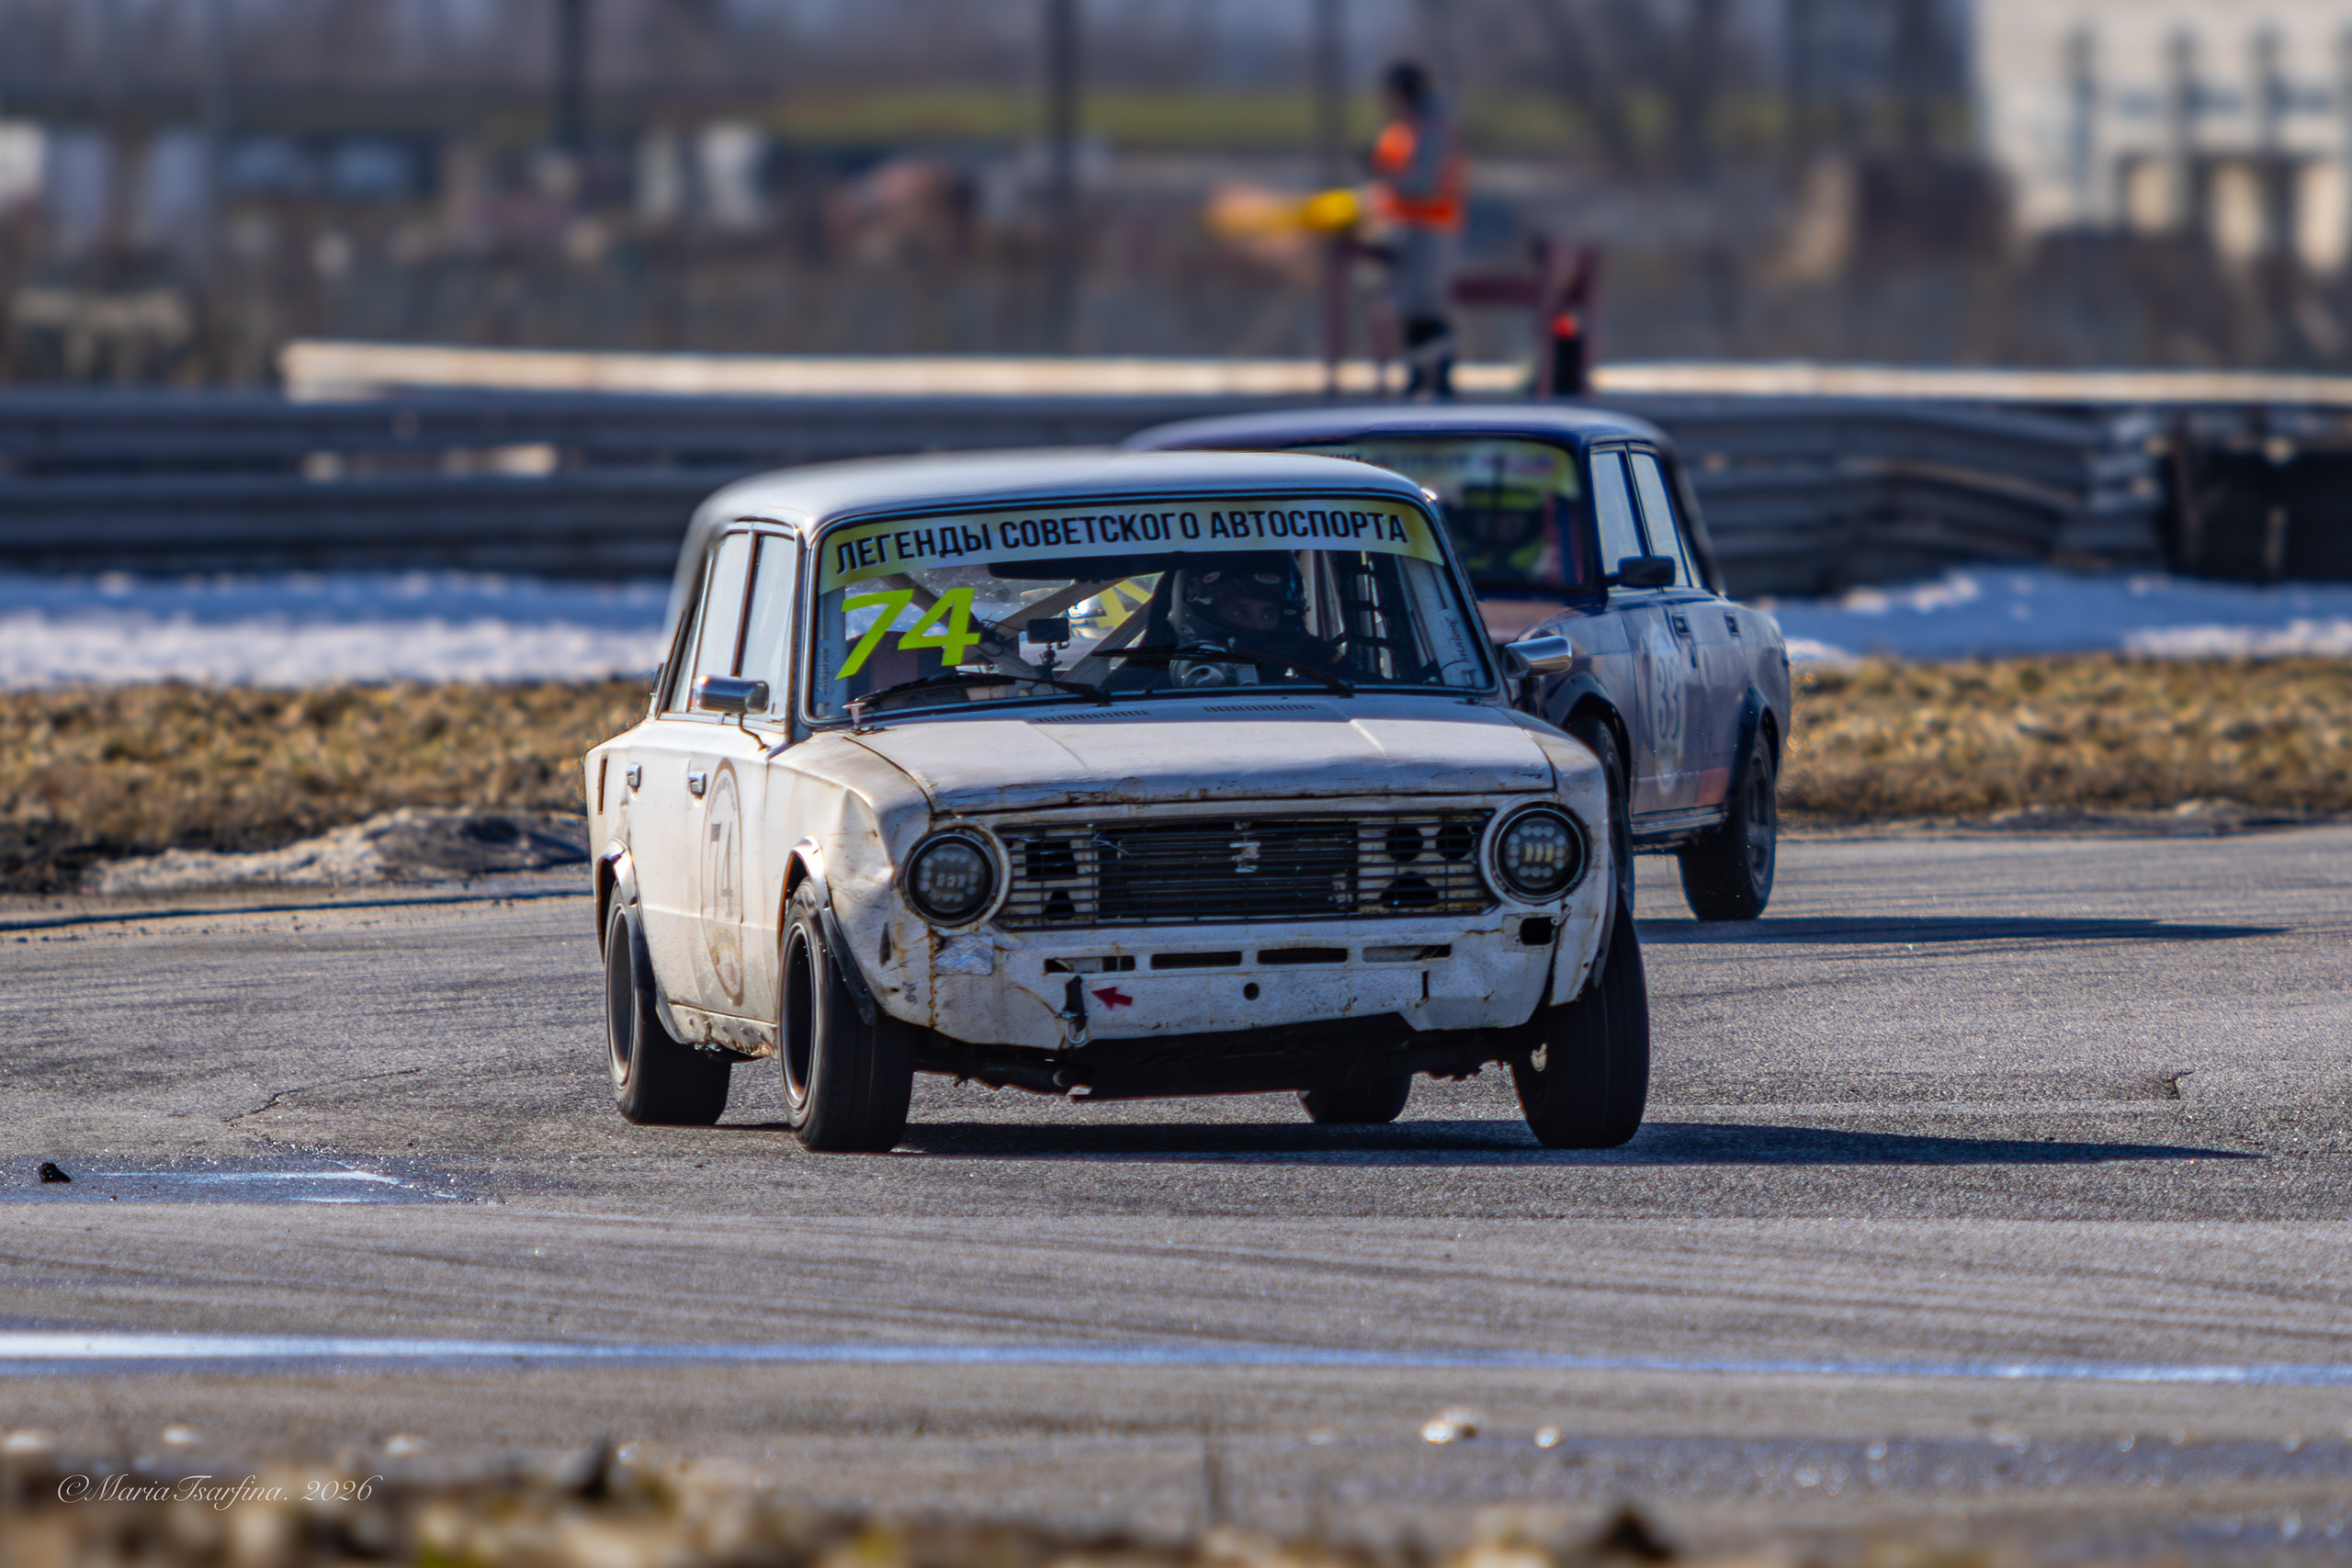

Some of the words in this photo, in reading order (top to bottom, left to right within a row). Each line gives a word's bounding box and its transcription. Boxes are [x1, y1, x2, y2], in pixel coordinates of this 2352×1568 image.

[836, 523, 992, 575] ЛЕГЕНДЫ
[999, 512, 1200, 548] СОВЕТСКОГО
[1210, 510, 1408, 544] АВТОСПОРТА
[835, 588, 980, 680] 74
